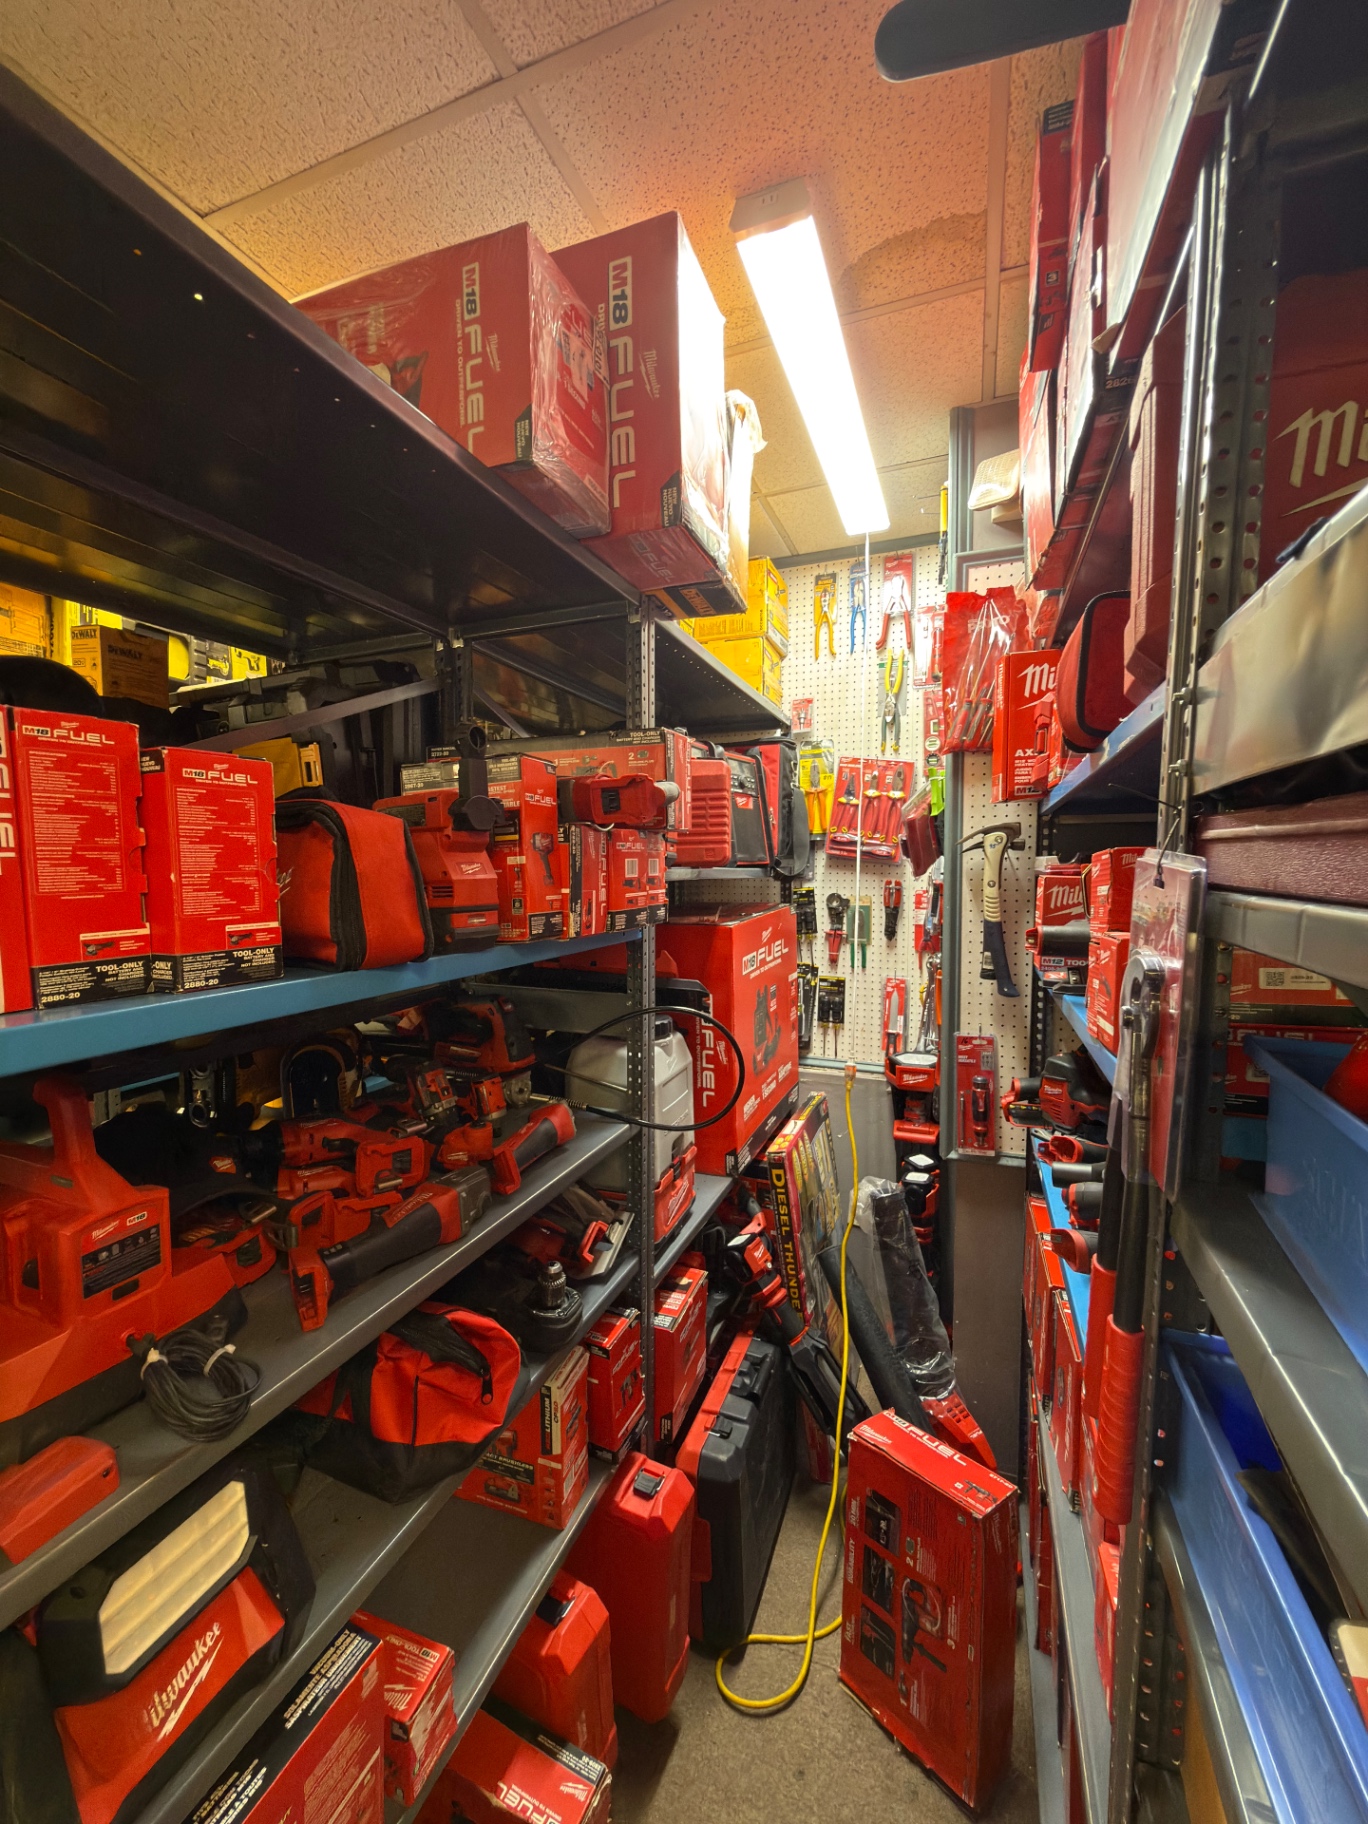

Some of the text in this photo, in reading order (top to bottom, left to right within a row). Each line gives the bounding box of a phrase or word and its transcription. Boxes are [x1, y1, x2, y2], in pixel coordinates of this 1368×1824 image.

[464, 263, 485, 454] M18 FUEL
[609, 258, 636, 508] M18 FUEL
[644, 349, 660, 399] Milwaukee
[22, 725, 115, 745] M18 FUEL
[628, 752, 635, 760] 2
[183, 768, 258, 784] M18 FUEL
[534, 795, 556, 805] FUEL
[233, 947, 275, 958] TOOL-ONLY
[743, 939, 789, 975] M18 FUEL
[1042, 957, 1064, 966] M12
[96, 961, 143, 973] TOOL-ONLY
[184, 979, 219, 989] 2880-20
[41, 991, 81, 1004] 2880-20
[701, 1029, 715, 1108] FUEL
[903, 1073, 928, 1082] Milwaukee
[92, 1211, 148, 1240] Milwaukee M18
[772, 1168, 804, 1319] DIESEL THUNDE
[859, 1425, 892, 1444] Milwaukee
[908, 1426, 967, 1466] FUEL
[147, 1621, 222, 1728] ilwaukee
[284, 1677, 321, 1719] SOLAMENTE
[319, 1631, 357, 1675] ASPIRADORA
[239, 1766, 268, 1800] TOUTES
[559, 1784, 588, 1803] Milwaukee
[497, 1781, 548, 1824] FUEL
